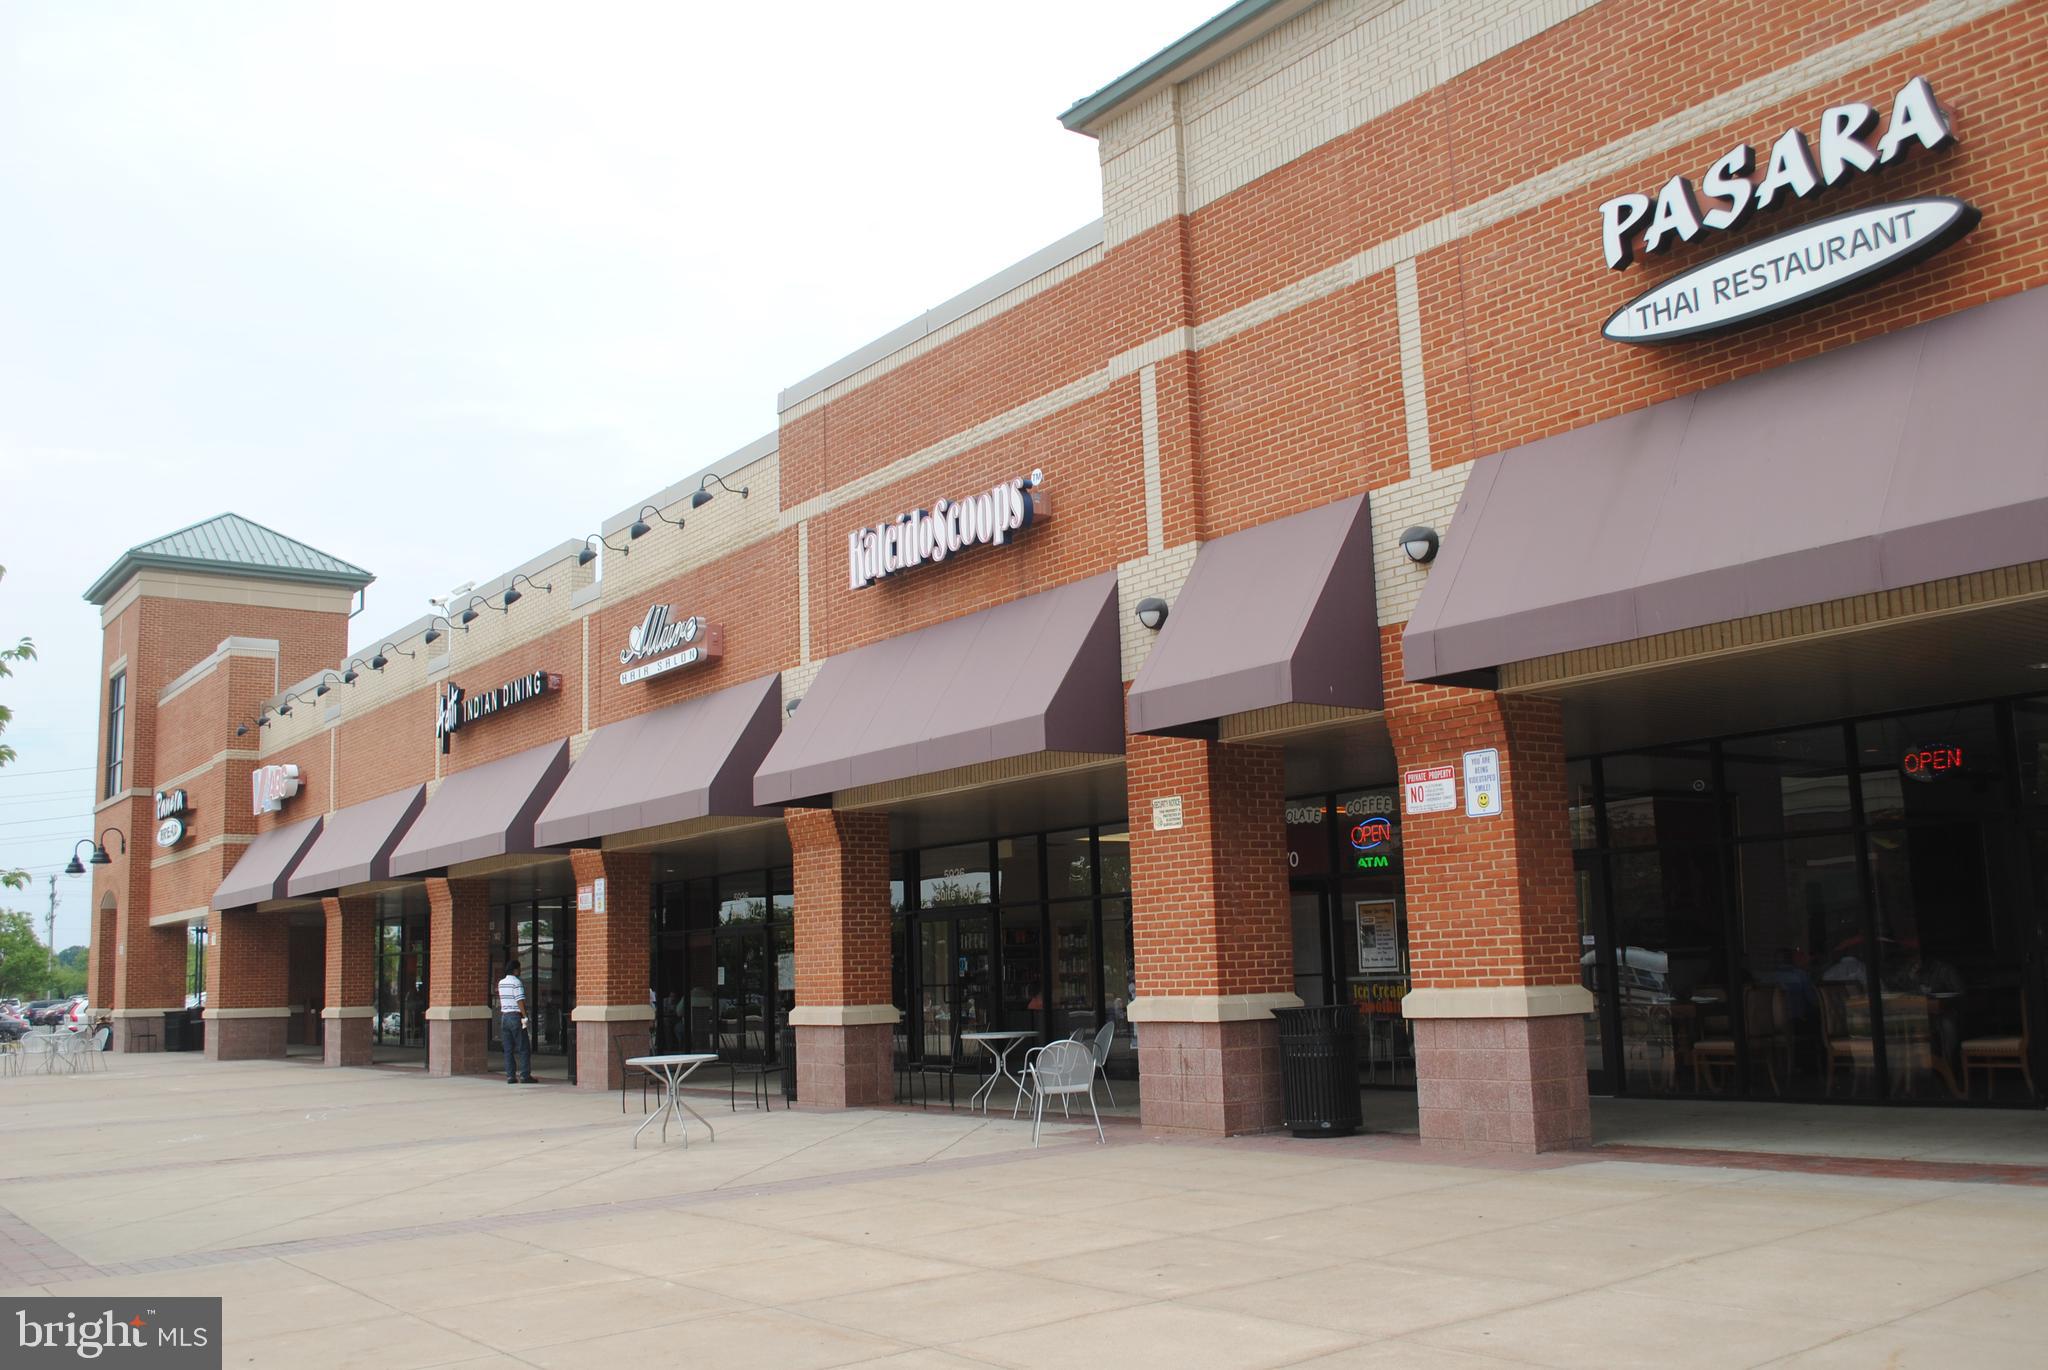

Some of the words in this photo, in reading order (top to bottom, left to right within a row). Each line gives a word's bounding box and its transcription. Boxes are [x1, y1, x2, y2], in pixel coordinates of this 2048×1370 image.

[1598, 75, 1950, 269] PASARA
[1635, 286, 1699, 330] THAI
[1713, 210, 1916, 305] RESTAURANT
[620, 603, 698, 664] Allure
[621, 666, 649, 683] HAIR
[657, 650, 696, 673] SALON
[463, 688, 498, 722] INDIAN
[502, 670, 541, 707] DINING
[1904, 747, 1962, 773] OPEN
[1345, 796, 1392, 815] COFFEE
[1410, 785, 1424, 803] NO
[1351, 824, 1390, 844] OPEN
[1358, 856, 1389, 868] ATM
[1353, 984, 1369, 999] Ice
